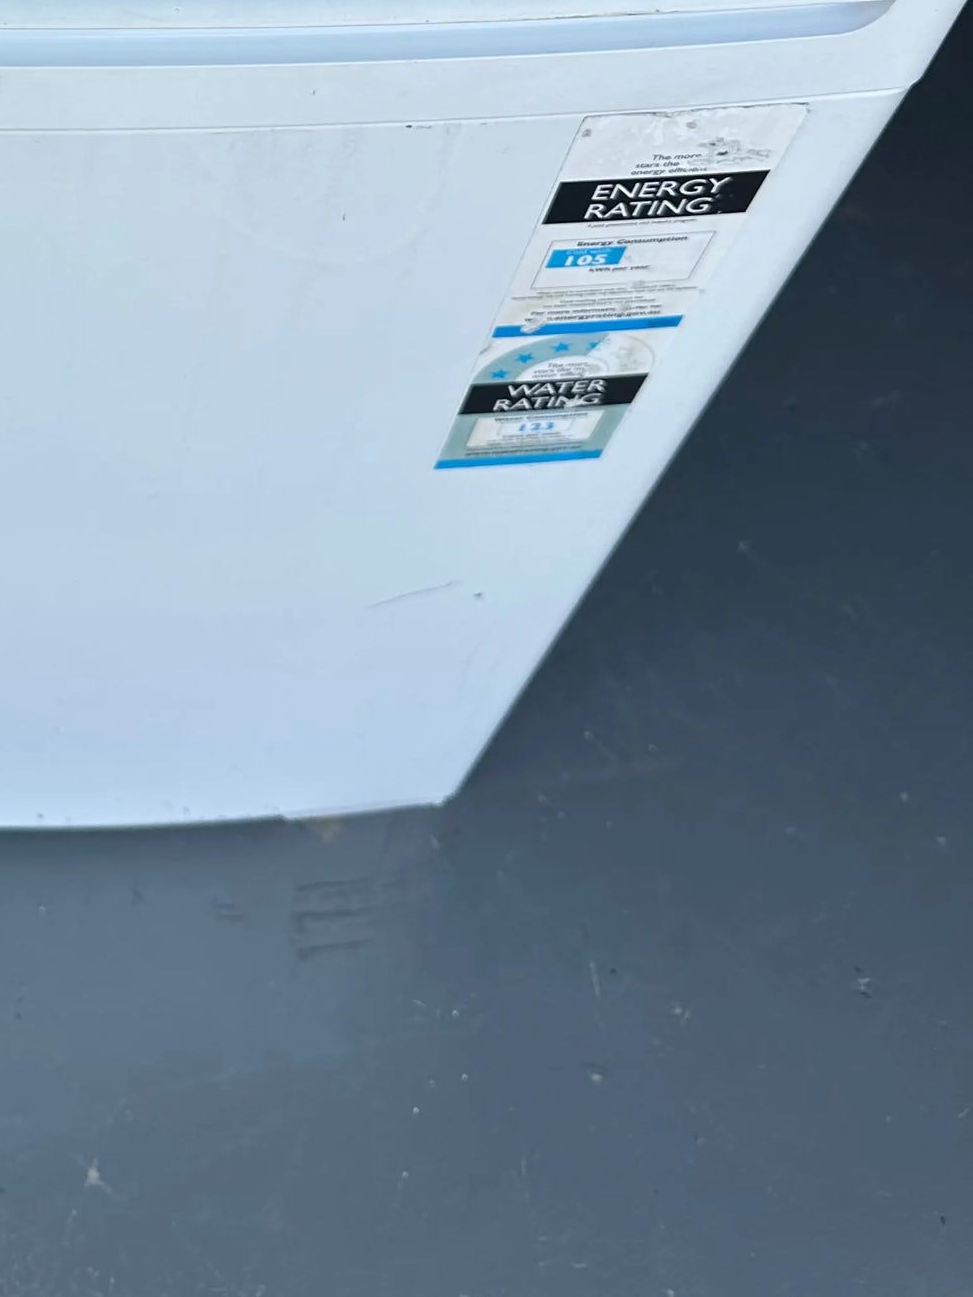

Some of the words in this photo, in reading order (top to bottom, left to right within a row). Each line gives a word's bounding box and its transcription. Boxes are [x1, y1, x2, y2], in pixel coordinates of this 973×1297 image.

[635, 161, 660, 169] stars
[592, 177, 734, 201] ENERGY
[583, 197, 714, 220] RATING
[576, 240, 614, 248] Energy
[616, 236, 689, 246] Consumption
[564, 254, 609, 267] 105
[508, 379, 607, 399] WATER
[493, 393, 601, 412] RATING
